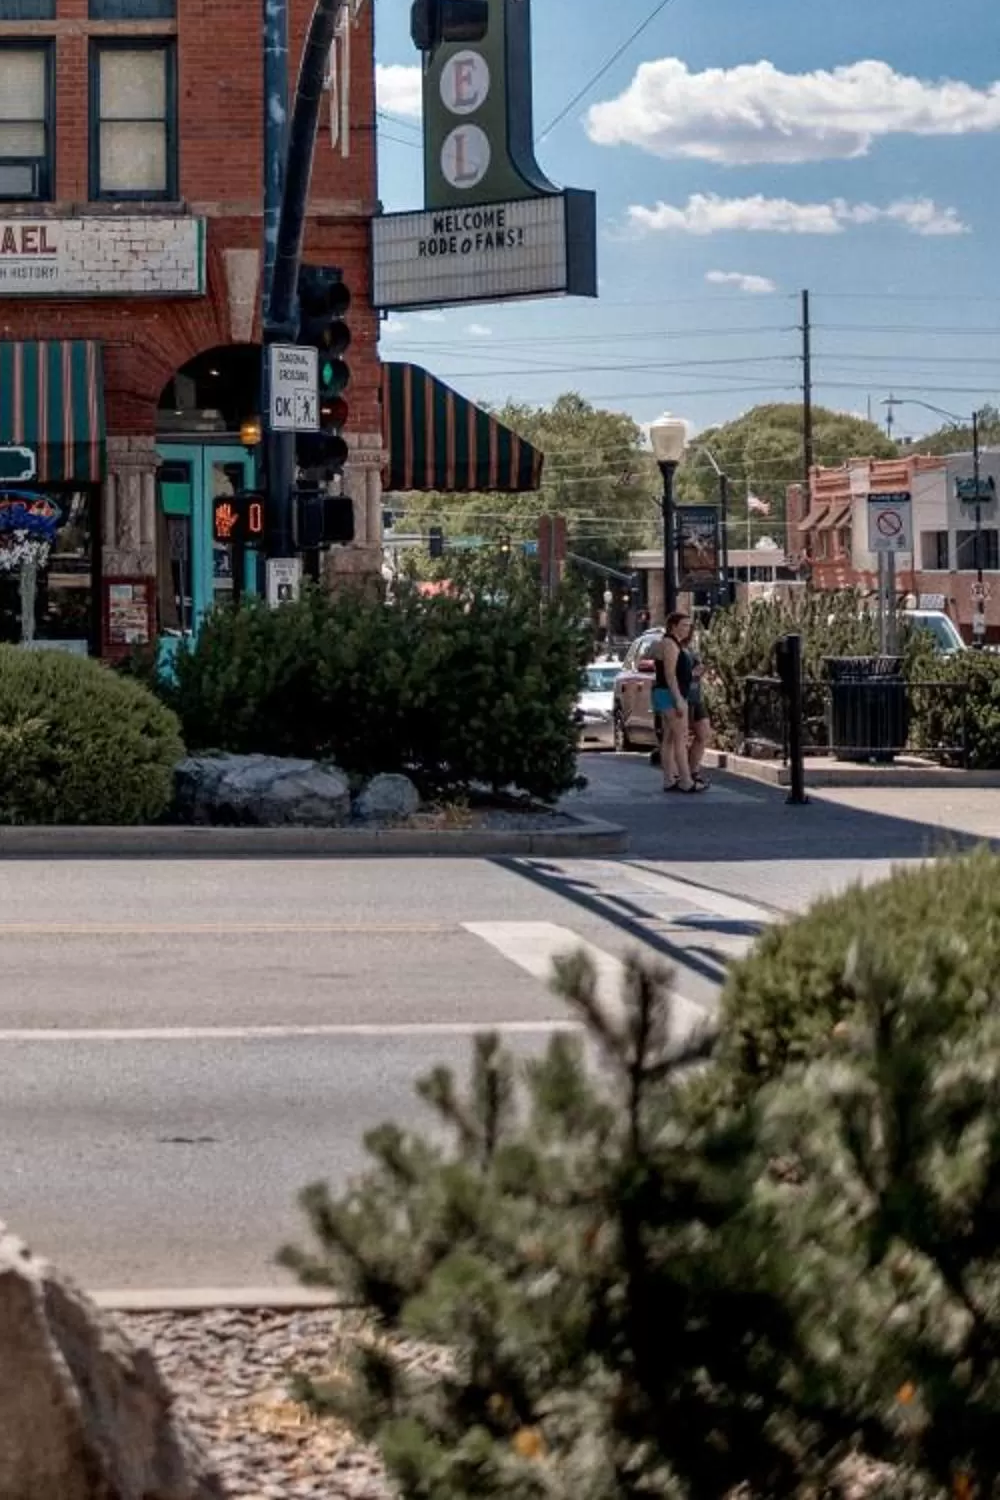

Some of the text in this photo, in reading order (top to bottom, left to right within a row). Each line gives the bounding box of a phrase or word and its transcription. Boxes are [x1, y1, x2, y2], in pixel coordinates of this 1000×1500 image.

[432, 209, 505, 234] WELCOME
[419, 228, 523, 257] RODEO FANS!
[275, 396, 292, 417] OK
